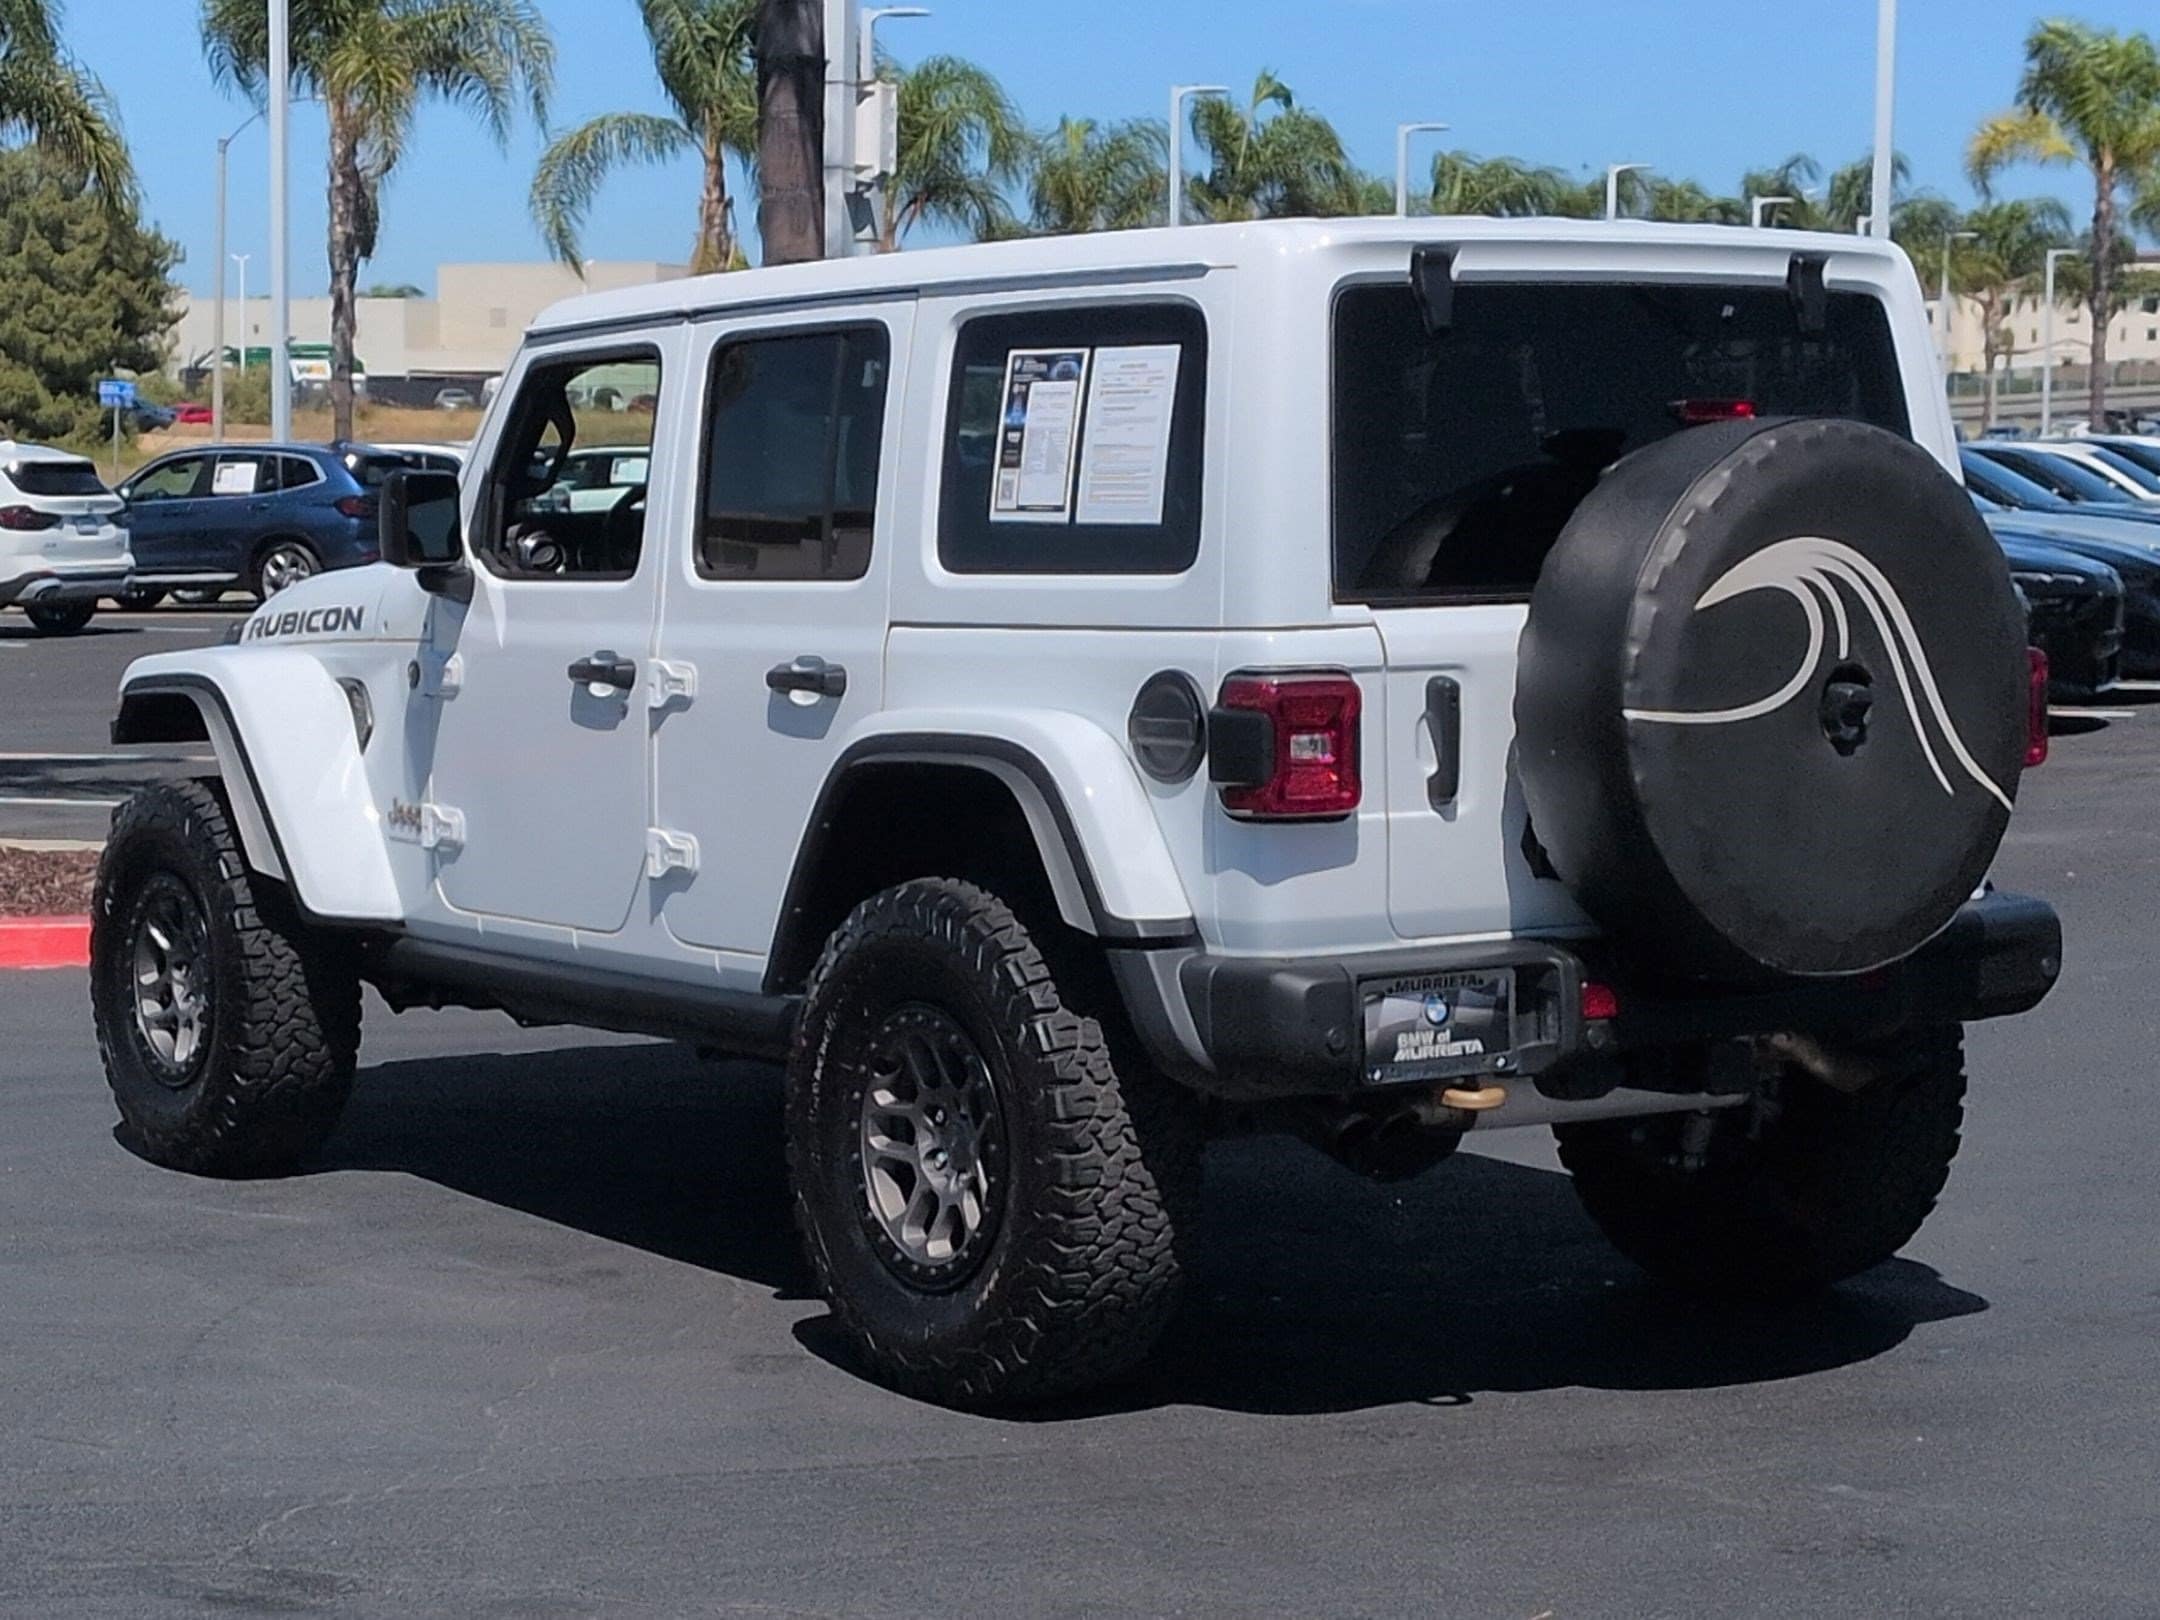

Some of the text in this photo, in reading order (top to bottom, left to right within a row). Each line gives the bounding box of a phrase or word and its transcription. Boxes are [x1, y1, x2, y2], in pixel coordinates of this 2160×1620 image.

[248, 606, 365, 641] RUBICON
[1394, 974, 1477, 993] MURRIETA
[1397, 1028, 1451, 1048] BMW of
[1393, 1038, 1484, 1063] MURRIETA
